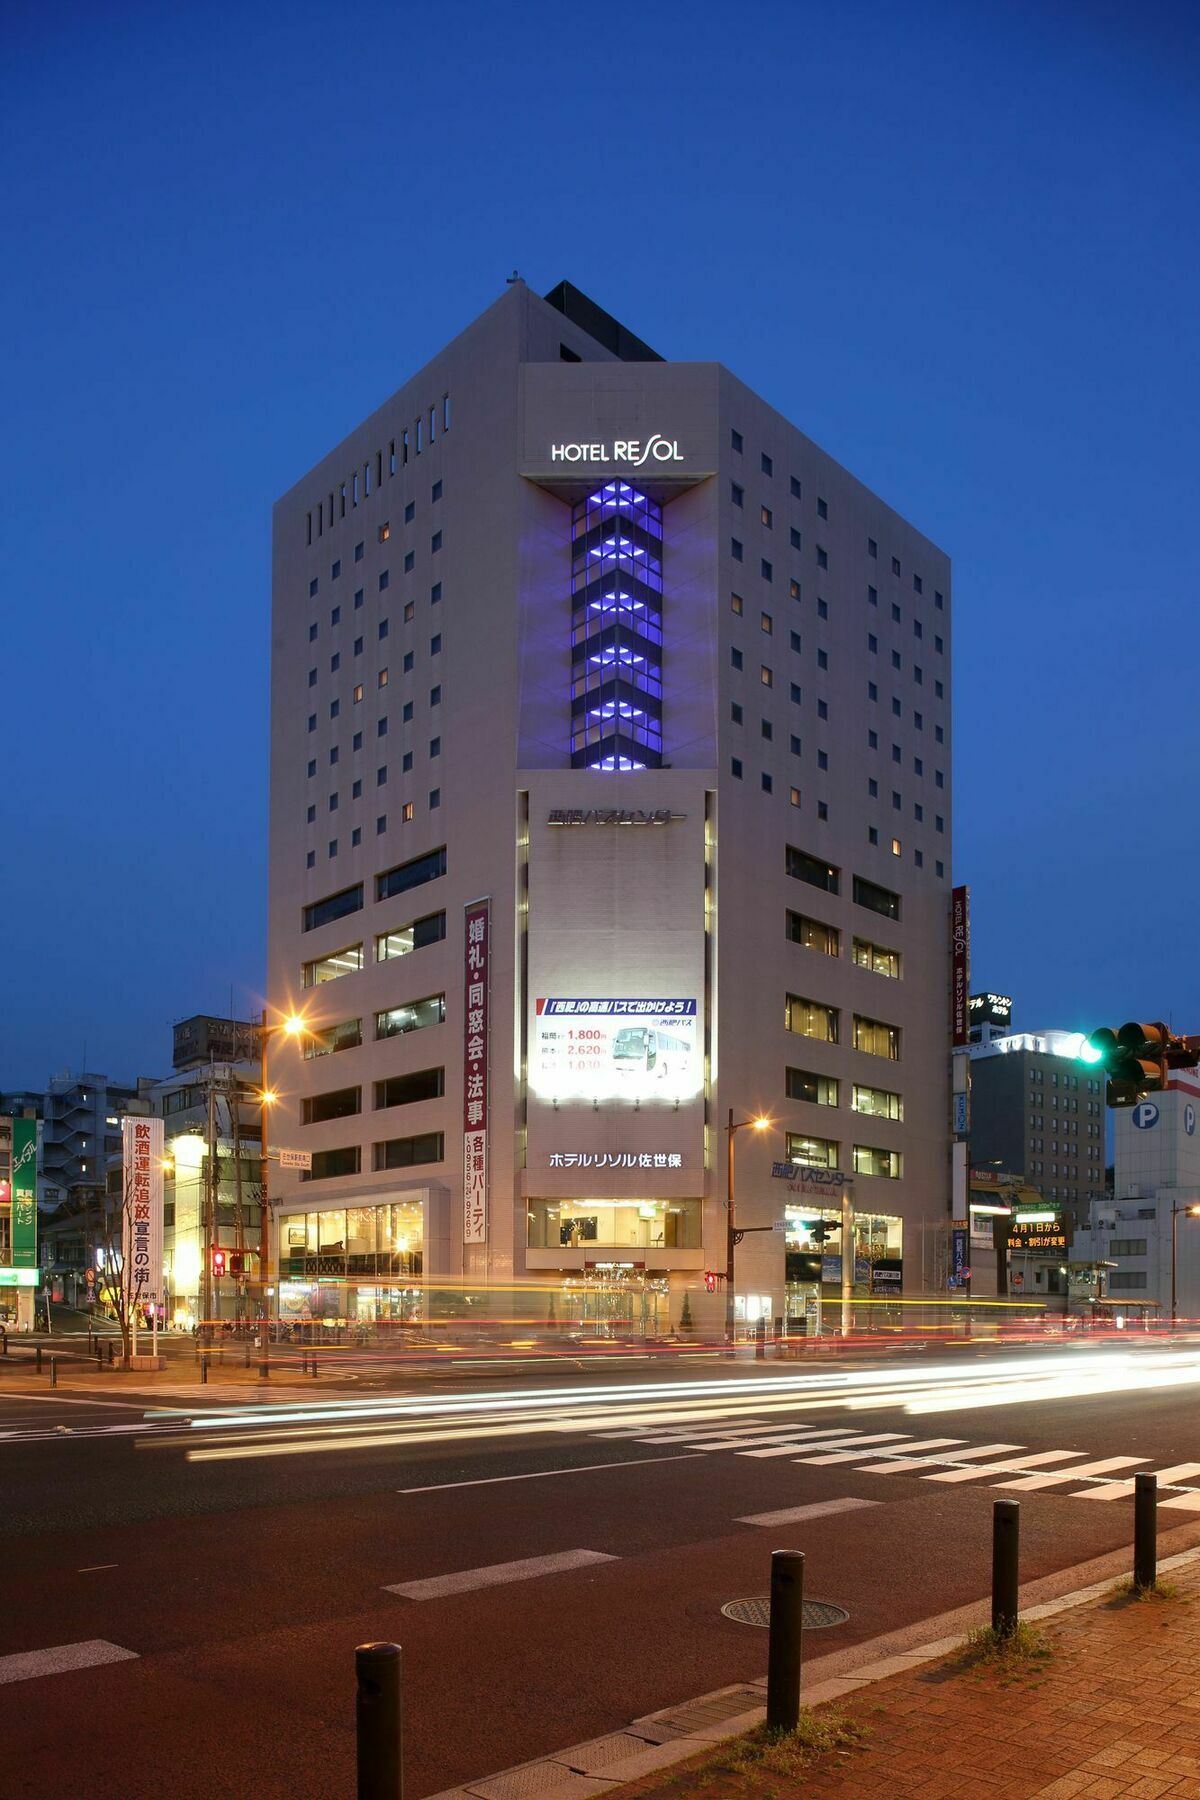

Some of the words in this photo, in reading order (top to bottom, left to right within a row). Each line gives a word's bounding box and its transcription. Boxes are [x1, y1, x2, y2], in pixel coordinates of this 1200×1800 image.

[552, 444, 609, 461] HOTEL
[614, 434, 684, 466] RESOL
[969, 997, 984, 1010] テル
[991, 1004, 1009, 1016] ホテル
[467, 917, 485, 1126] 婚礼・同窓会・法事
[549, 1153, 683, 1168] ホテルリソル佐世保
[472, 1135, 485, 1237] 各種パーティ
[771, 1162, 854, 1186] 西肥バスセンター
[134, 1123, 151, 1284] 飲酒運転追放宣言の街
[1007, 1236, 1066, 1248] 料金・割引が変更
